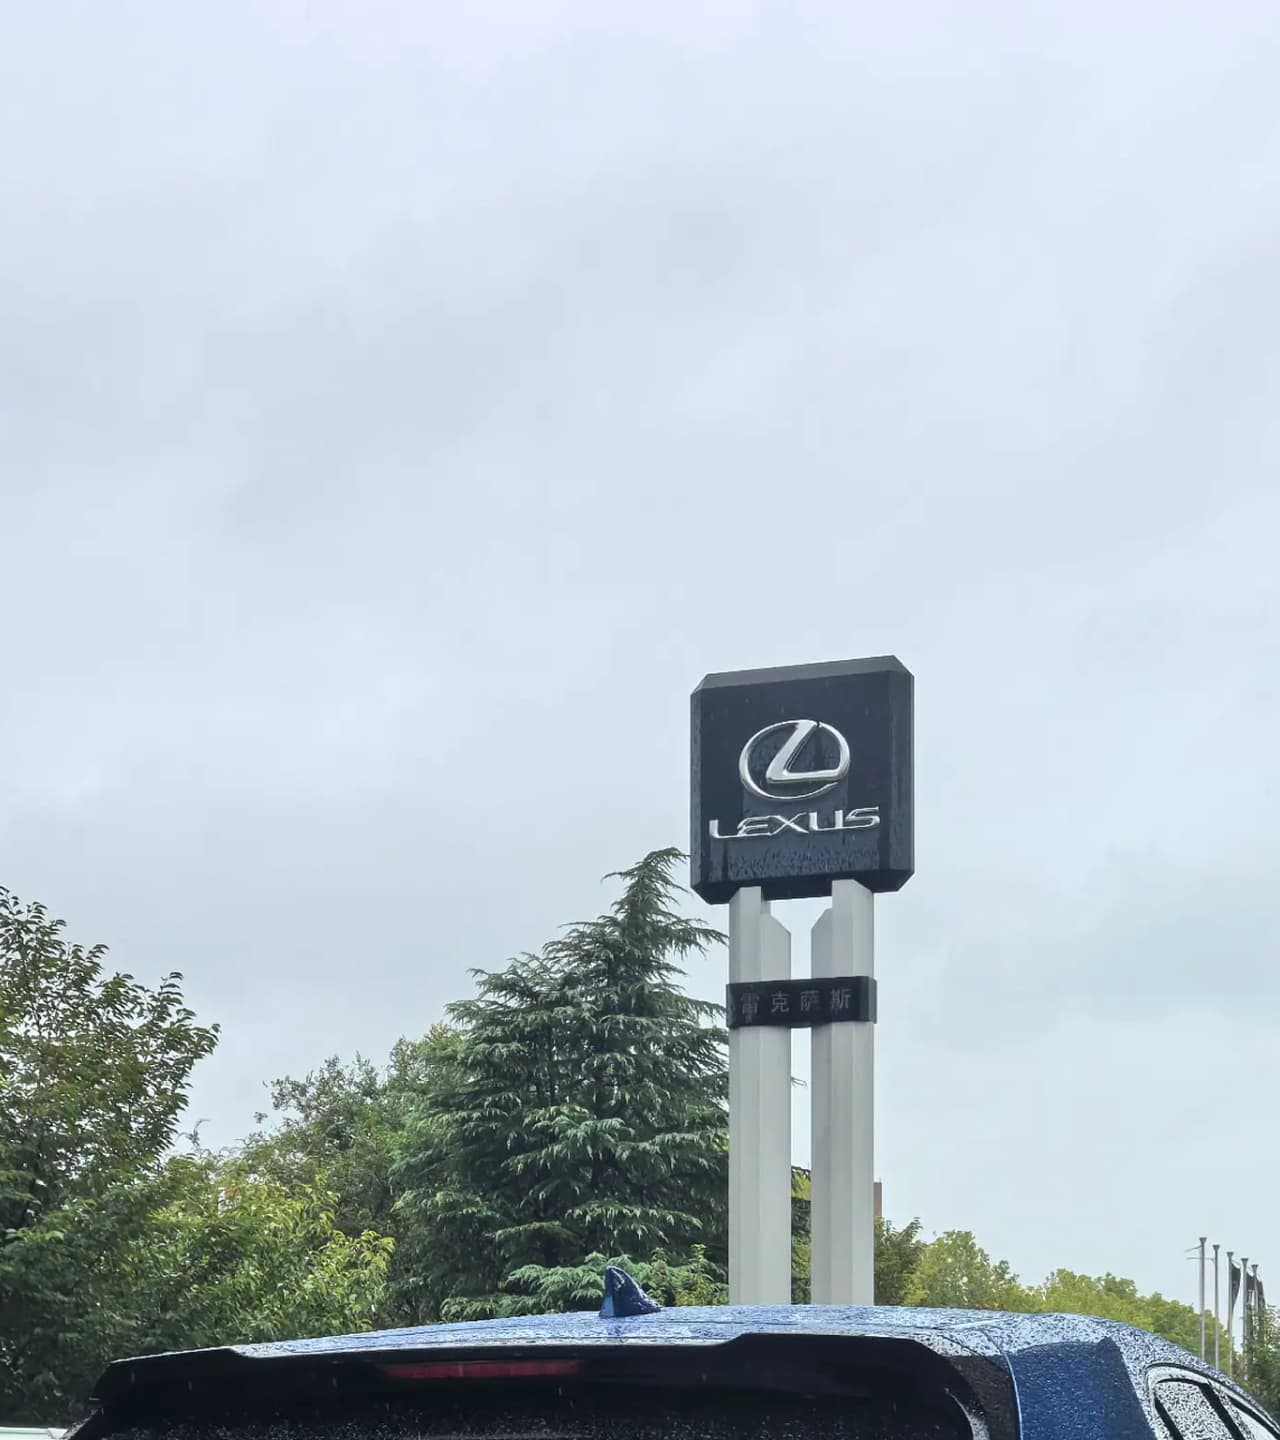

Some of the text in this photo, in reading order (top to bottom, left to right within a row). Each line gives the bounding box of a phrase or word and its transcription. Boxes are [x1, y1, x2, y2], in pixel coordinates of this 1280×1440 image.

[708, 805, 881, 839] LEXUS
[740, 988, 853, 1023] 雷克萨斯
